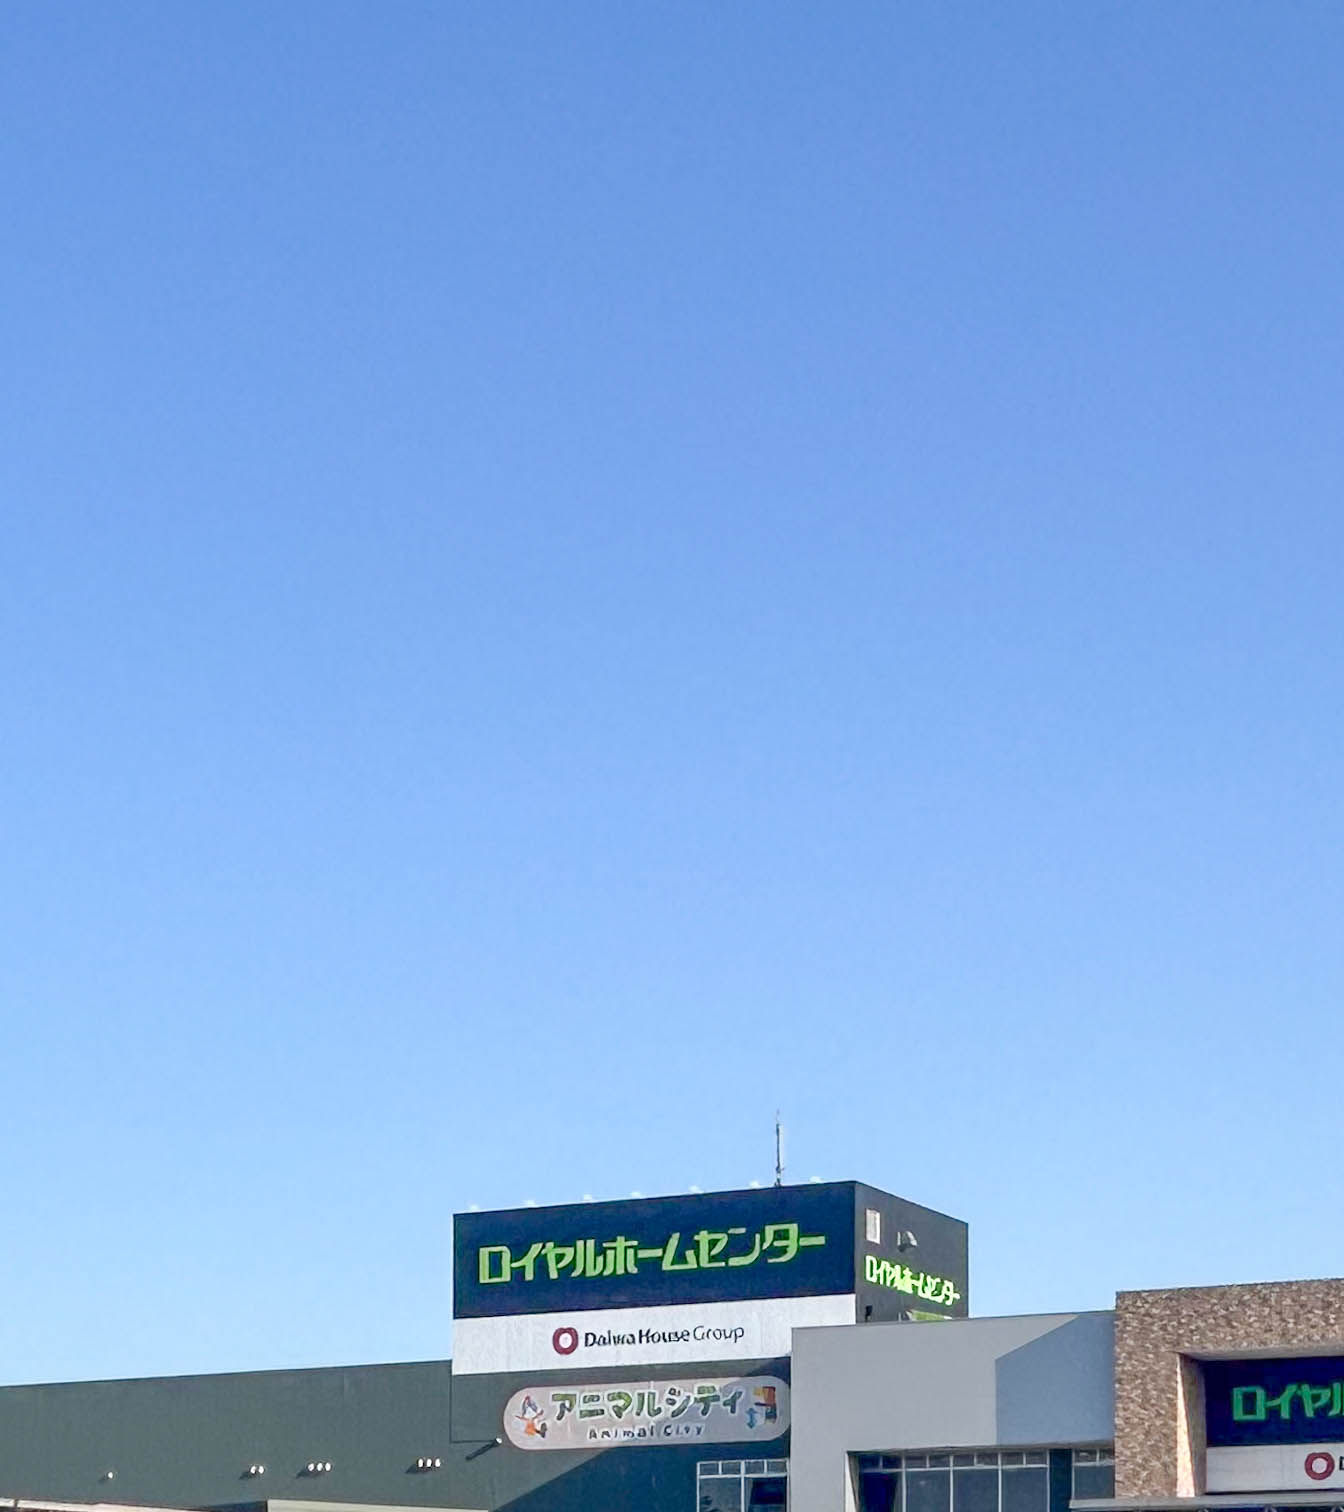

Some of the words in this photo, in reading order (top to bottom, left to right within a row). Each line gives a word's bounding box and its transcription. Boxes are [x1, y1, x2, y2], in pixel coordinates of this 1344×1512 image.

[478, 1222, 827, 1285] ロイヤルホームセンター
[584, 1330, 636, 1347] Daiwa
[638, 1328, 690, 1345] House
[693, 1325, 745, 1343] Group
[551, 1385, 744, 1422] アニマルシティ
